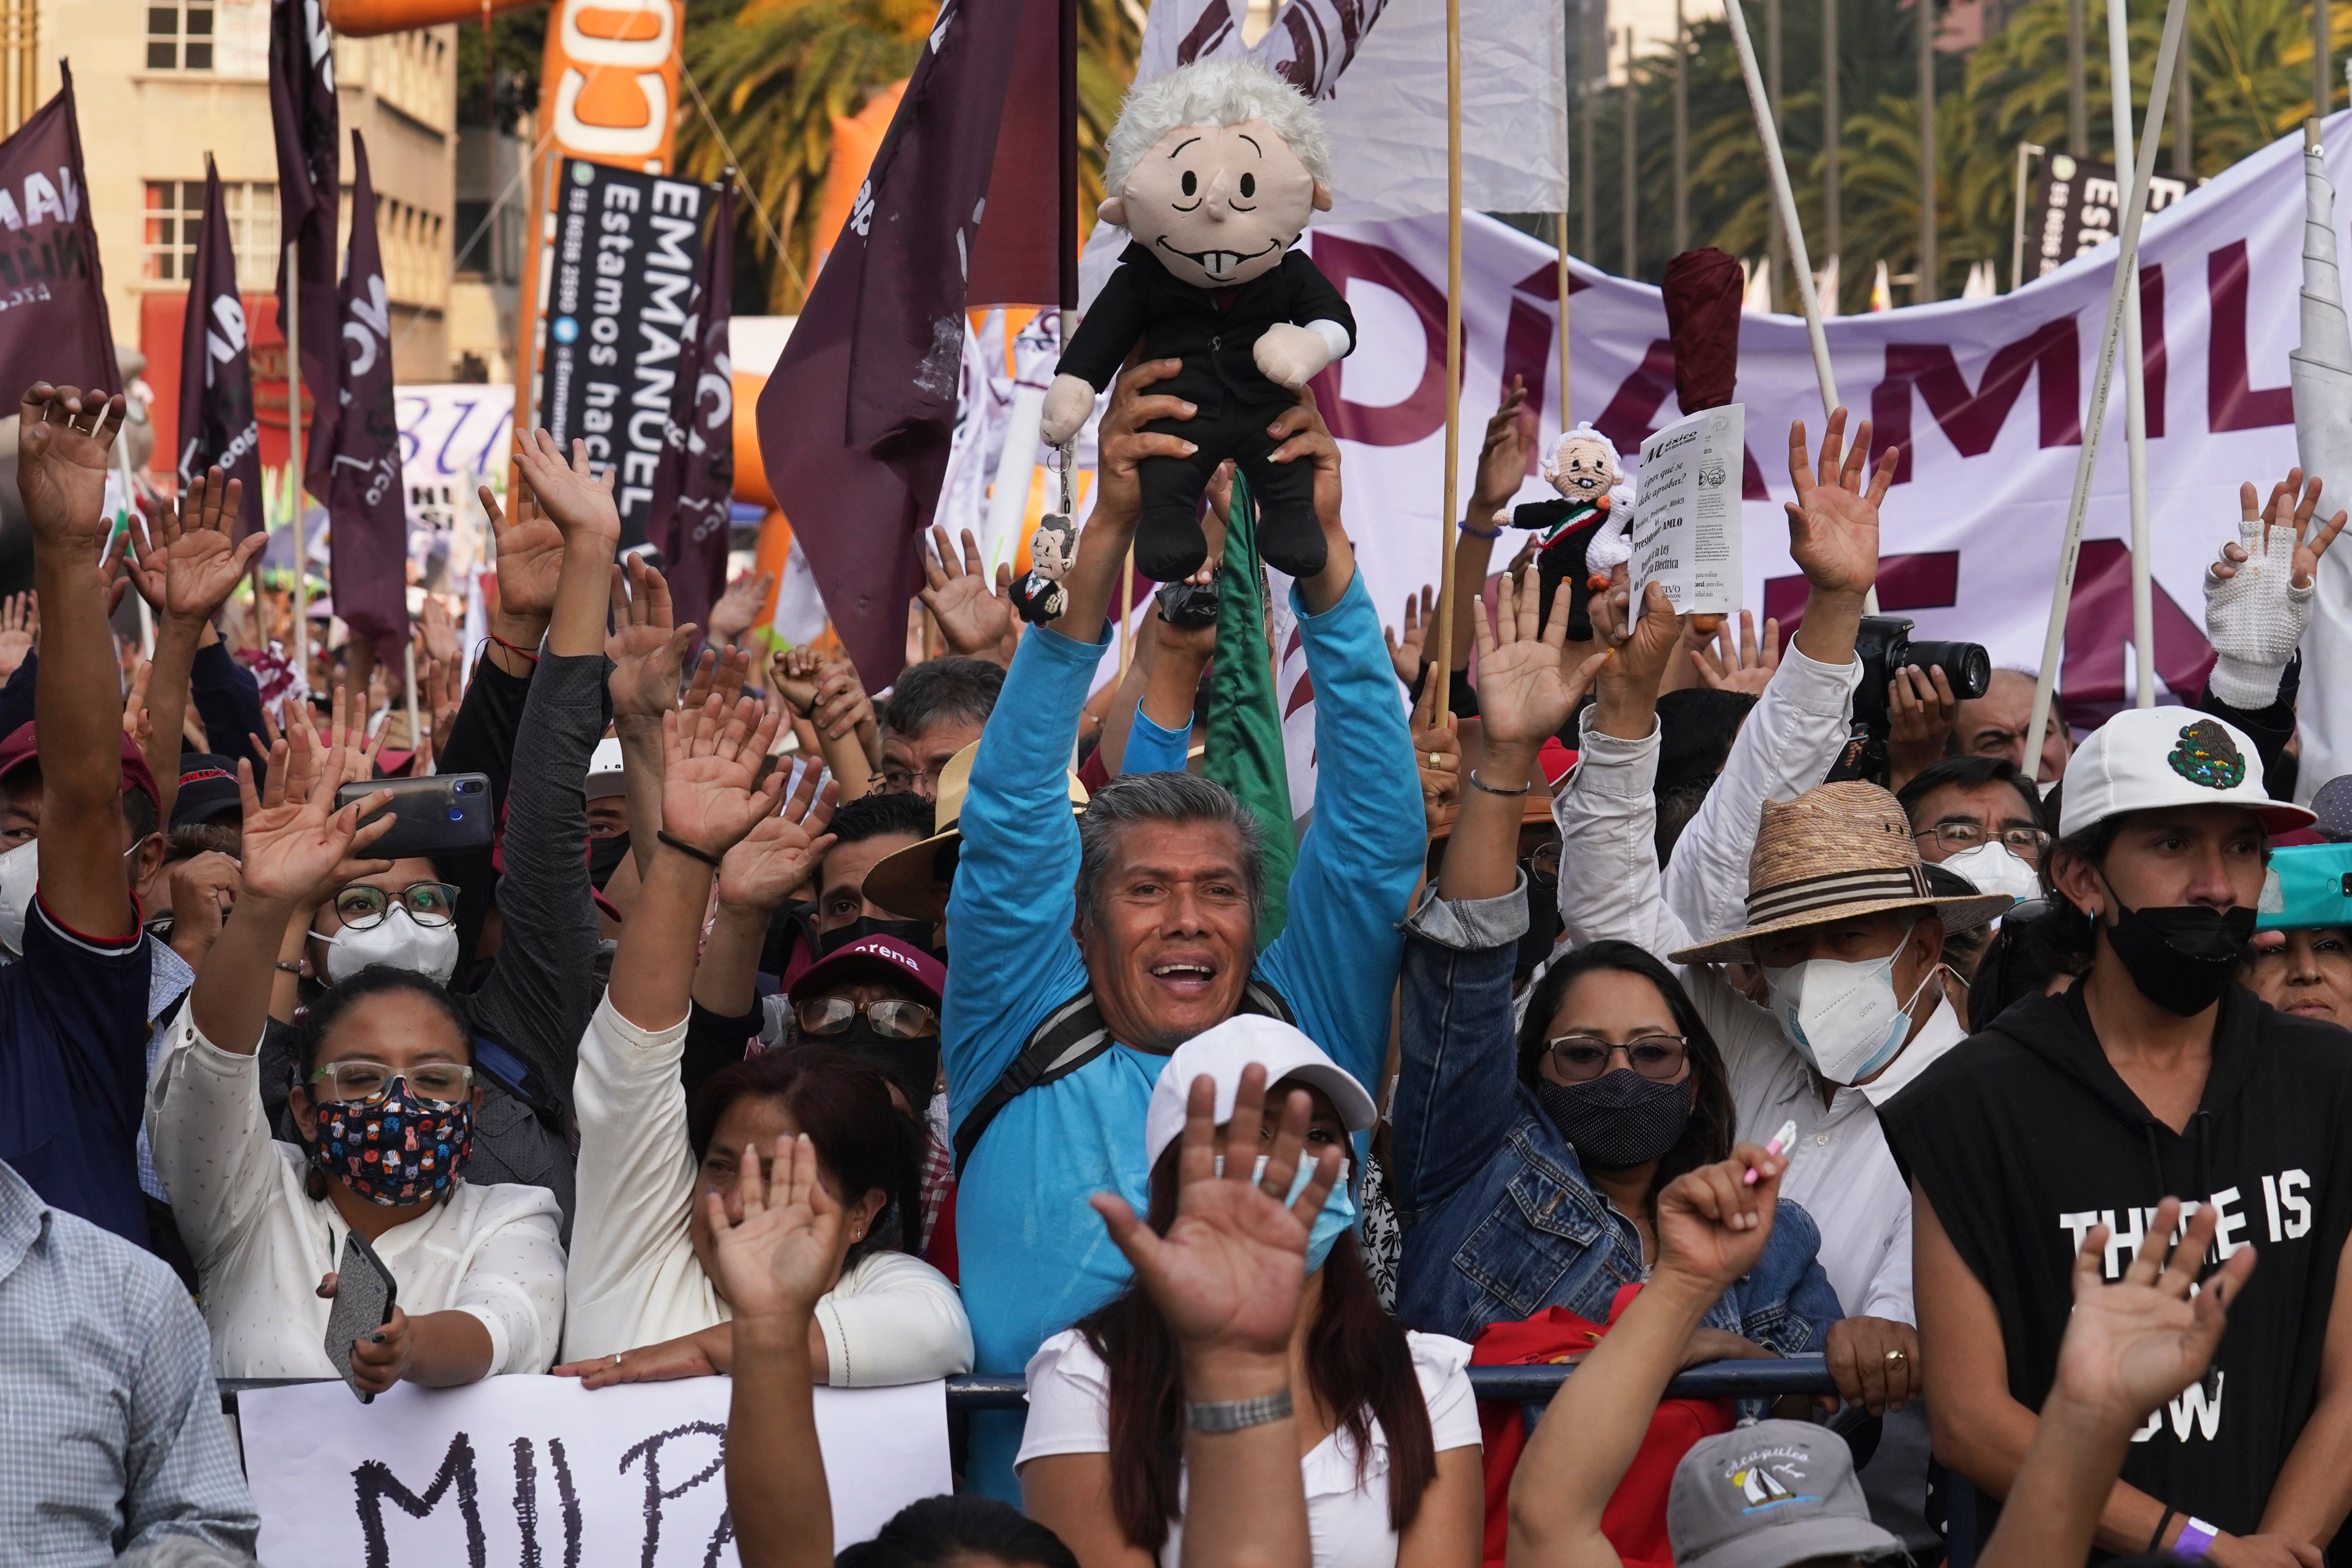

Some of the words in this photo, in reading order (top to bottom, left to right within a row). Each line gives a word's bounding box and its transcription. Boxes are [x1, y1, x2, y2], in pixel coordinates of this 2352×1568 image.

[589, 183, 640, 366] Estamos
[1660, 463, 1674, 480] qué
[1675, 462, 1684, 471] se
[1639, 491, 1651, 507] debe
[1652, 473, 1686, 498] aprobar?
[1634, 526, 1662, 553] Presidente
[1662, 517, 1683, 531] AMLO
[1661, 544, 1670, 555] Ley
[1655, 558, 1679, 572] Eléctrica
[1859, 1000, 1877, 1019] KN95
[2261, 1169, 2312, 1243] IS
